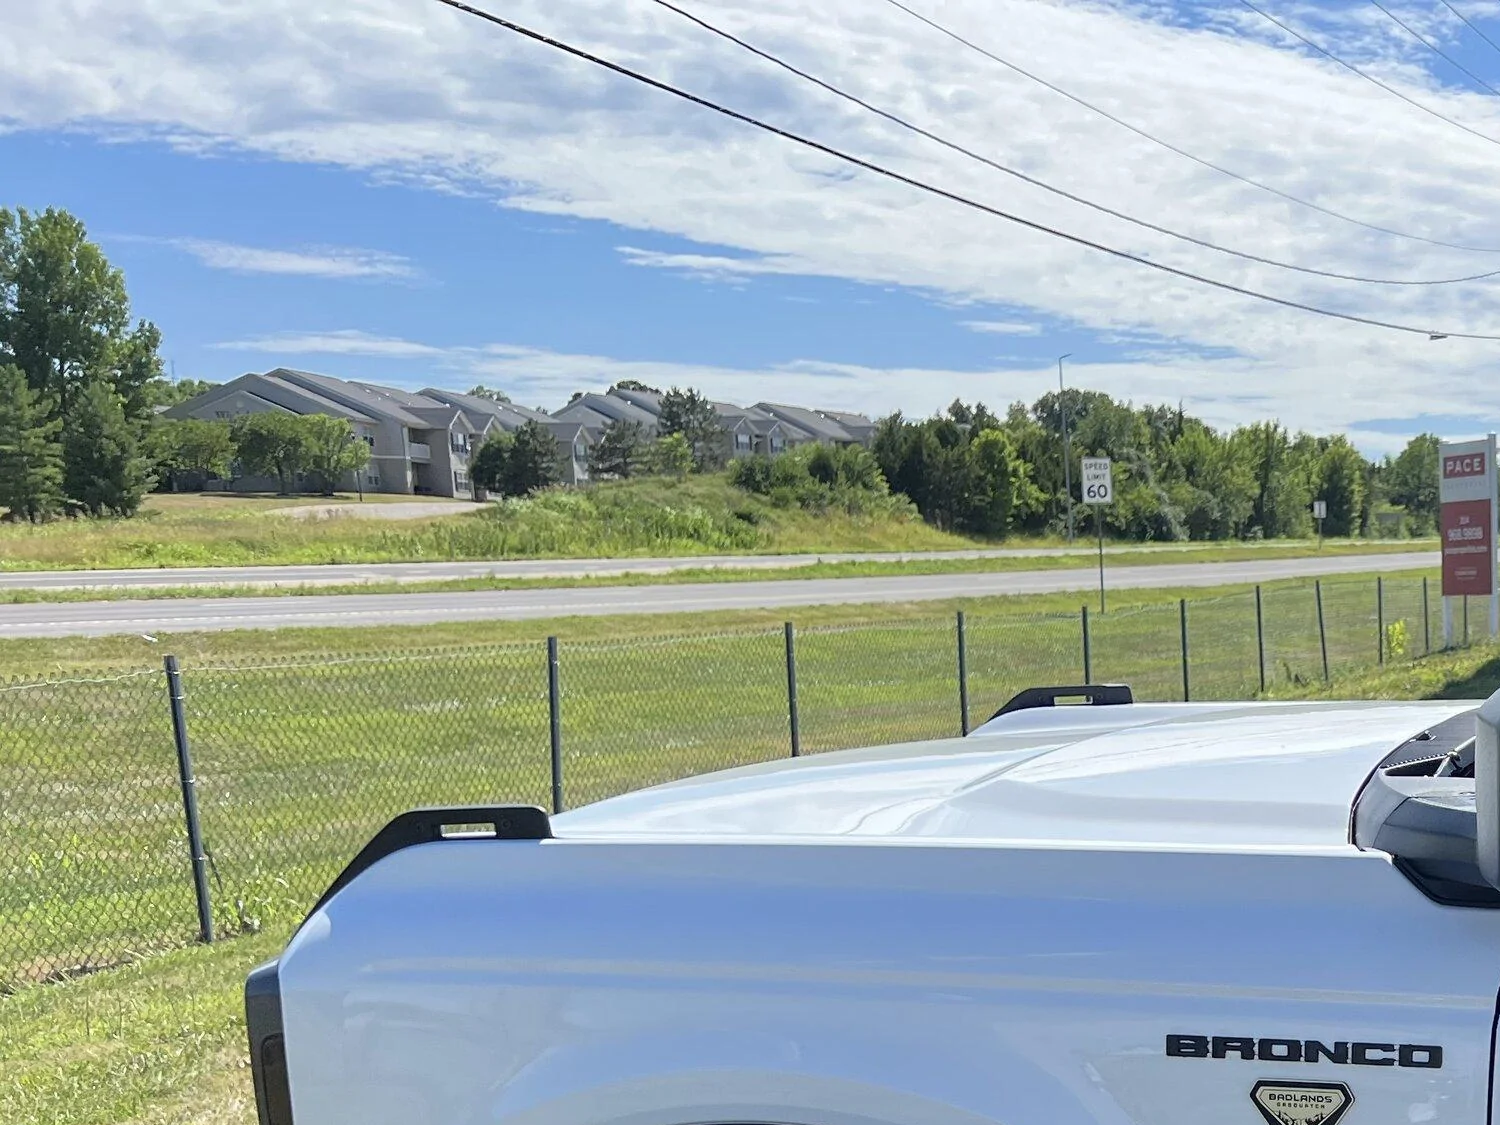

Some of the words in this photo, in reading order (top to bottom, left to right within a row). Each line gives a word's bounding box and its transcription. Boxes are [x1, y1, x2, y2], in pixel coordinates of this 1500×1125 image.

[1084, 462, 1108, 471] SPEED
[1446, 458, 1482, 475] PACE
[1086, 473, 1106, 481] LIMIT
[1087, 484, 1108, 499] 60
[1166, 1034, 1443, 1068] BRONCO
[1268, 1092, 1333, 1104] BADLANDS
